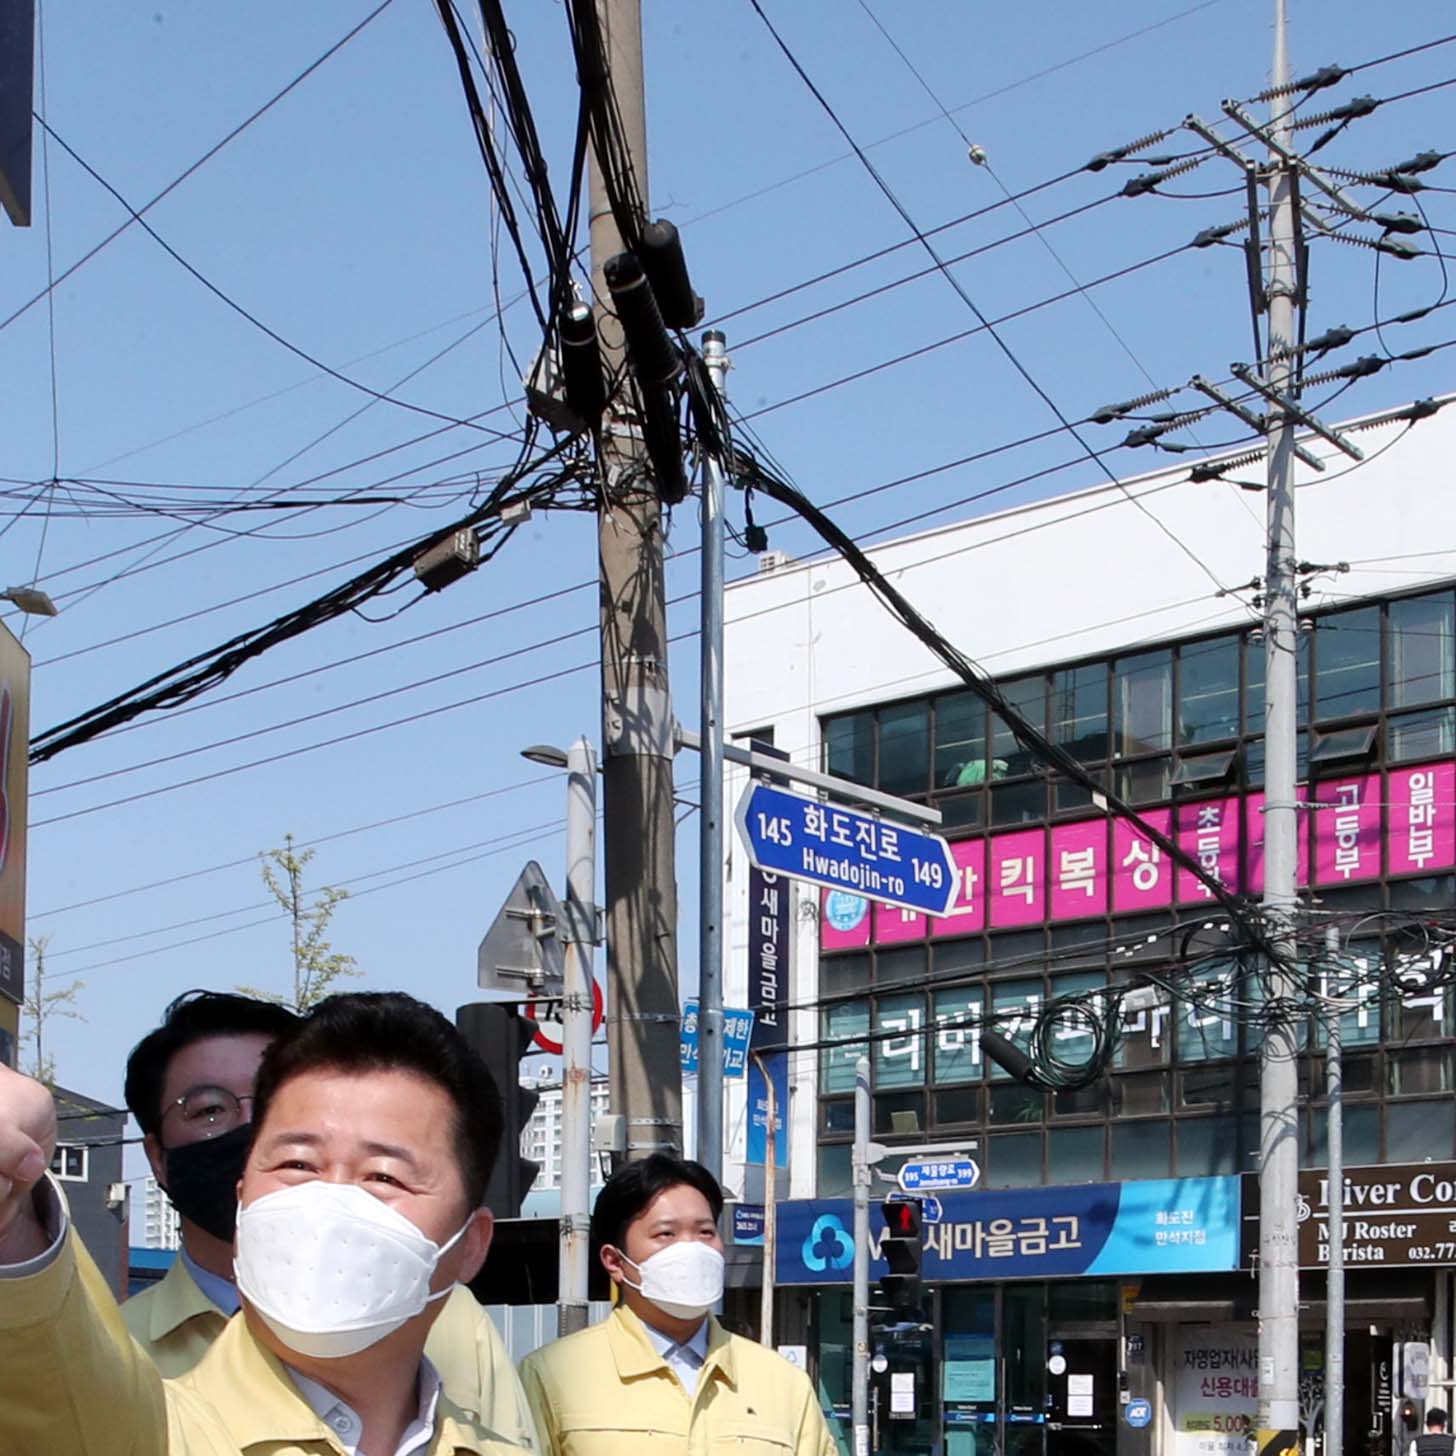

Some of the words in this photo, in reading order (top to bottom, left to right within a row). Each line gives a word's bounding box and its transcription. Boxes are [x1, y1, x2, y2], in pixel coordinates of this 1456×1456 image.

[757, 812, 793, 847] 145
[803, 804, 902, 862] 화도진로
[1334, 783, 1361, 879] 고등부
[1407, 771, 1437, 869] 일반부
[802, 847, 905, 896] Hwadojin-ro
[911, 857, 943, 889] 149
[922, 1215, 1082, 1262] 새마을금고
[1317, 1244, 1385, 1262] Brista
[1355, 1221, 1417, 1240] Roster
